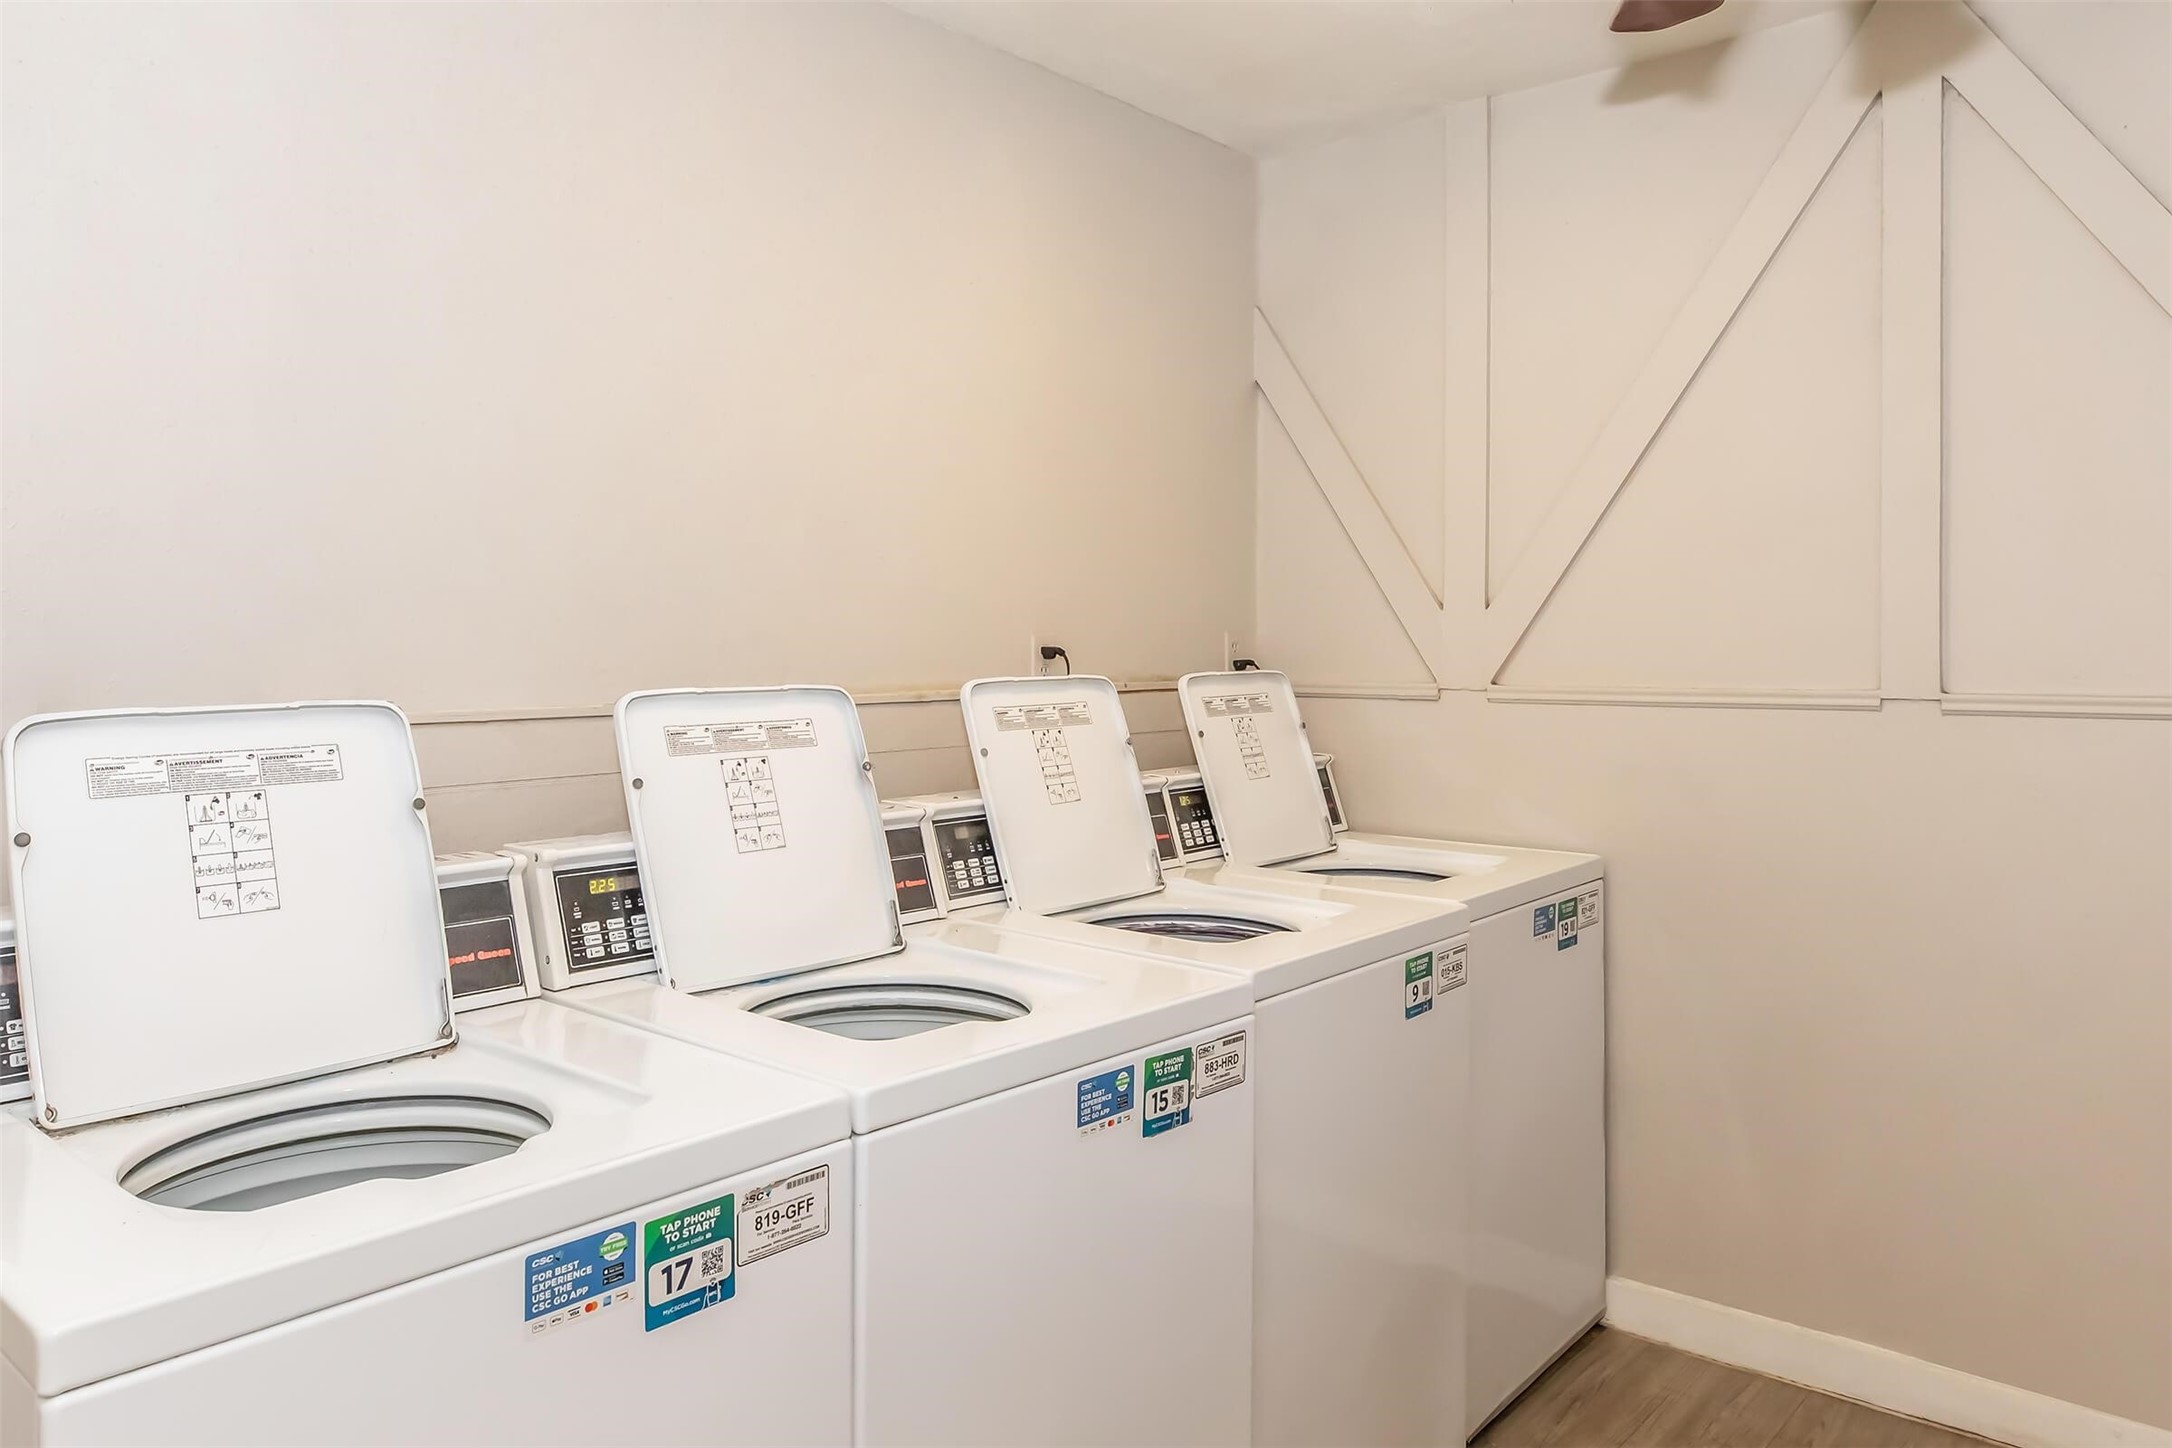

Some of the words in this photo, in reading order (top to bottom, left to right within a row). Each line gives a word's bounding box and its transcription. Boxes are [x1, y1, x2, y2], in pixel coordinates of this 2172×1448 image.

[1561, 922, 1569, 937] 19
[449, 952, 475, 966] peed
[1412, 984, 1418, 1002] 9
[1153, 1060, 1164, 1069] TAP
[1165, 1055, 1185, 1067] PHONE
[1155, 1069, 1163, 1077] TO
[1164, 1064, 1182, 1074] START
[1204, 1054, 1239, 1074] 883-HRD
[1092, 1089, 1105, 1098] BEST
[1152, 1089, 1168, 1114] 15
[660, 1220, 681, 1235] TAP
[684, 1206, 721, 1228] PHONE
[755, 1196, 814, 1231] 819-GFF
[665, 1231, 680, 1244] TO
[682, 1218, 716, 1238] START
[532, 1254, 554, 1268] CSC
[532, 1270, 552, 1284] FOR
[554, 1260, 580, 1276] BEST
[532, 1265, 593, 1294] EXPERIENCE
[661, 1257, 694, 1295] 17
[532, 1290, 551, 1303] USE
[553, 1282, 573, 1295] THE
[532, 1300, 551, 1313] CSC
[553, 1294, 568, 1306] GO
[570, 1286, 589, 1299] APP
